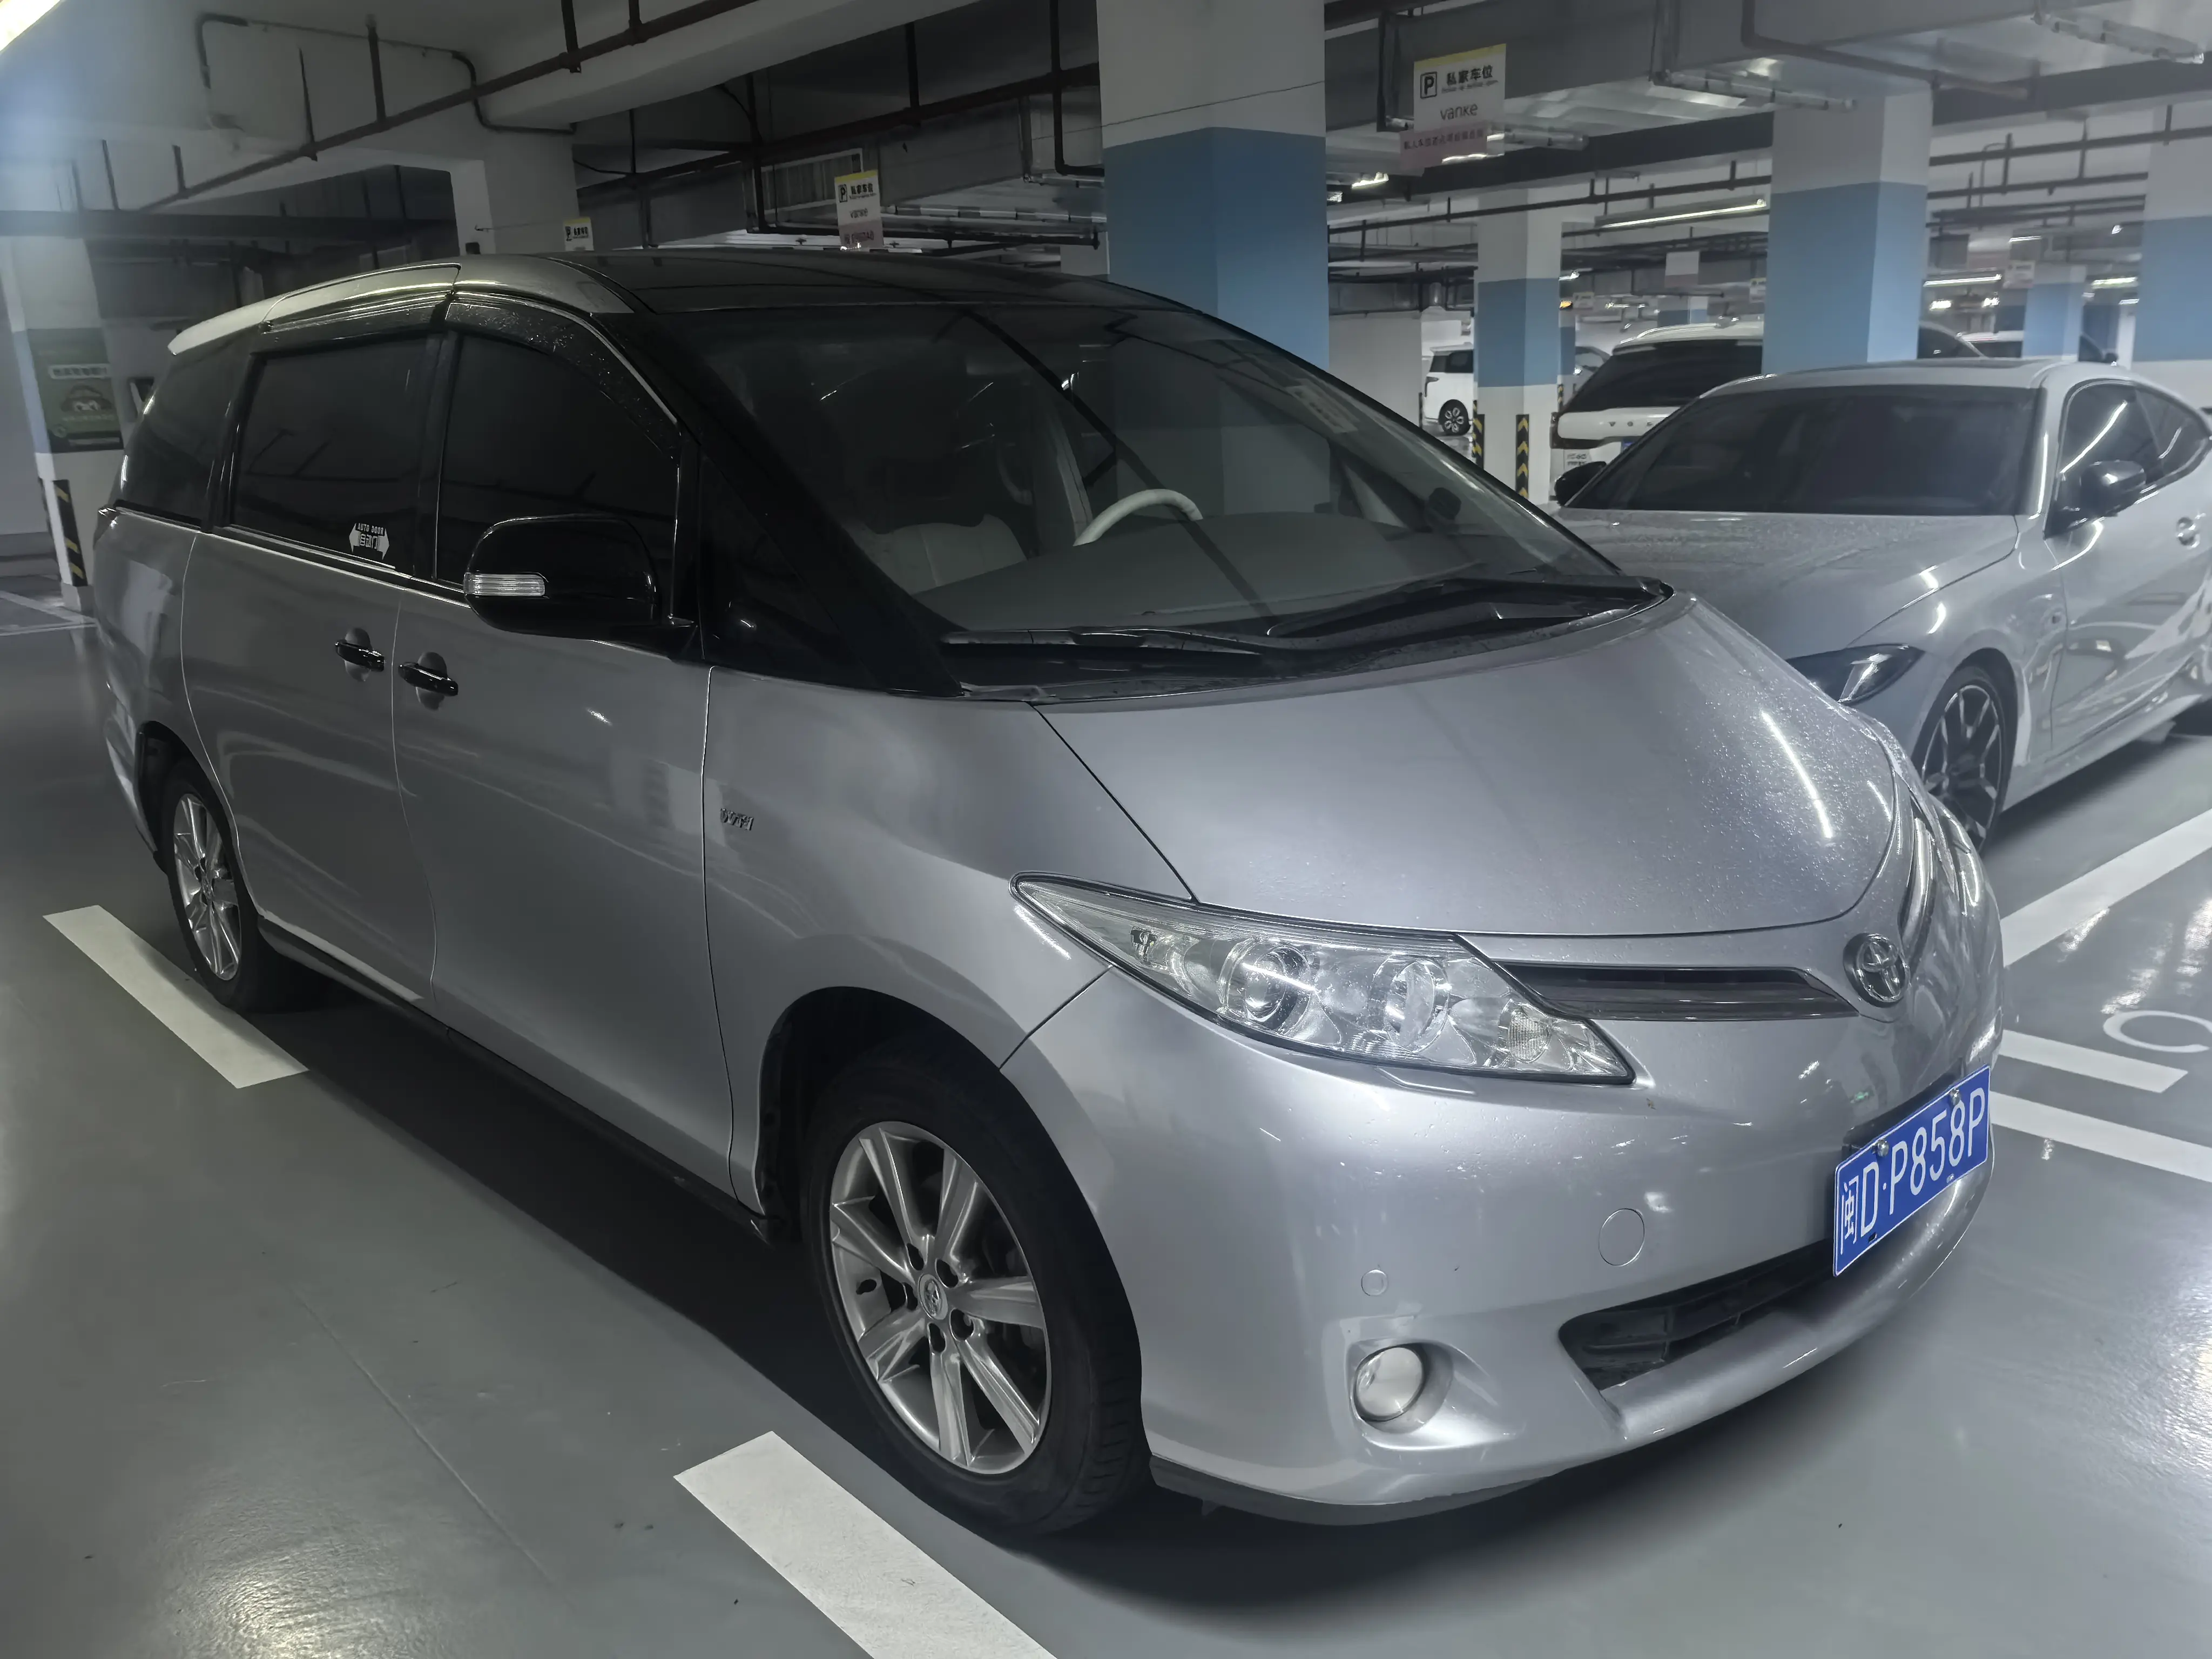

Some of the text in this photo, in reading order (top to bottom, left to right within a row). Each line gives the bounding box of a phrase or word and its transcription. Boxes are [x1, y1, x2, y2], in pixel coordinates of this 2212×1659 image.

[1440, 103, 1479, 120] vanke
[358, 523, 384, 536] AUTO DOOR
